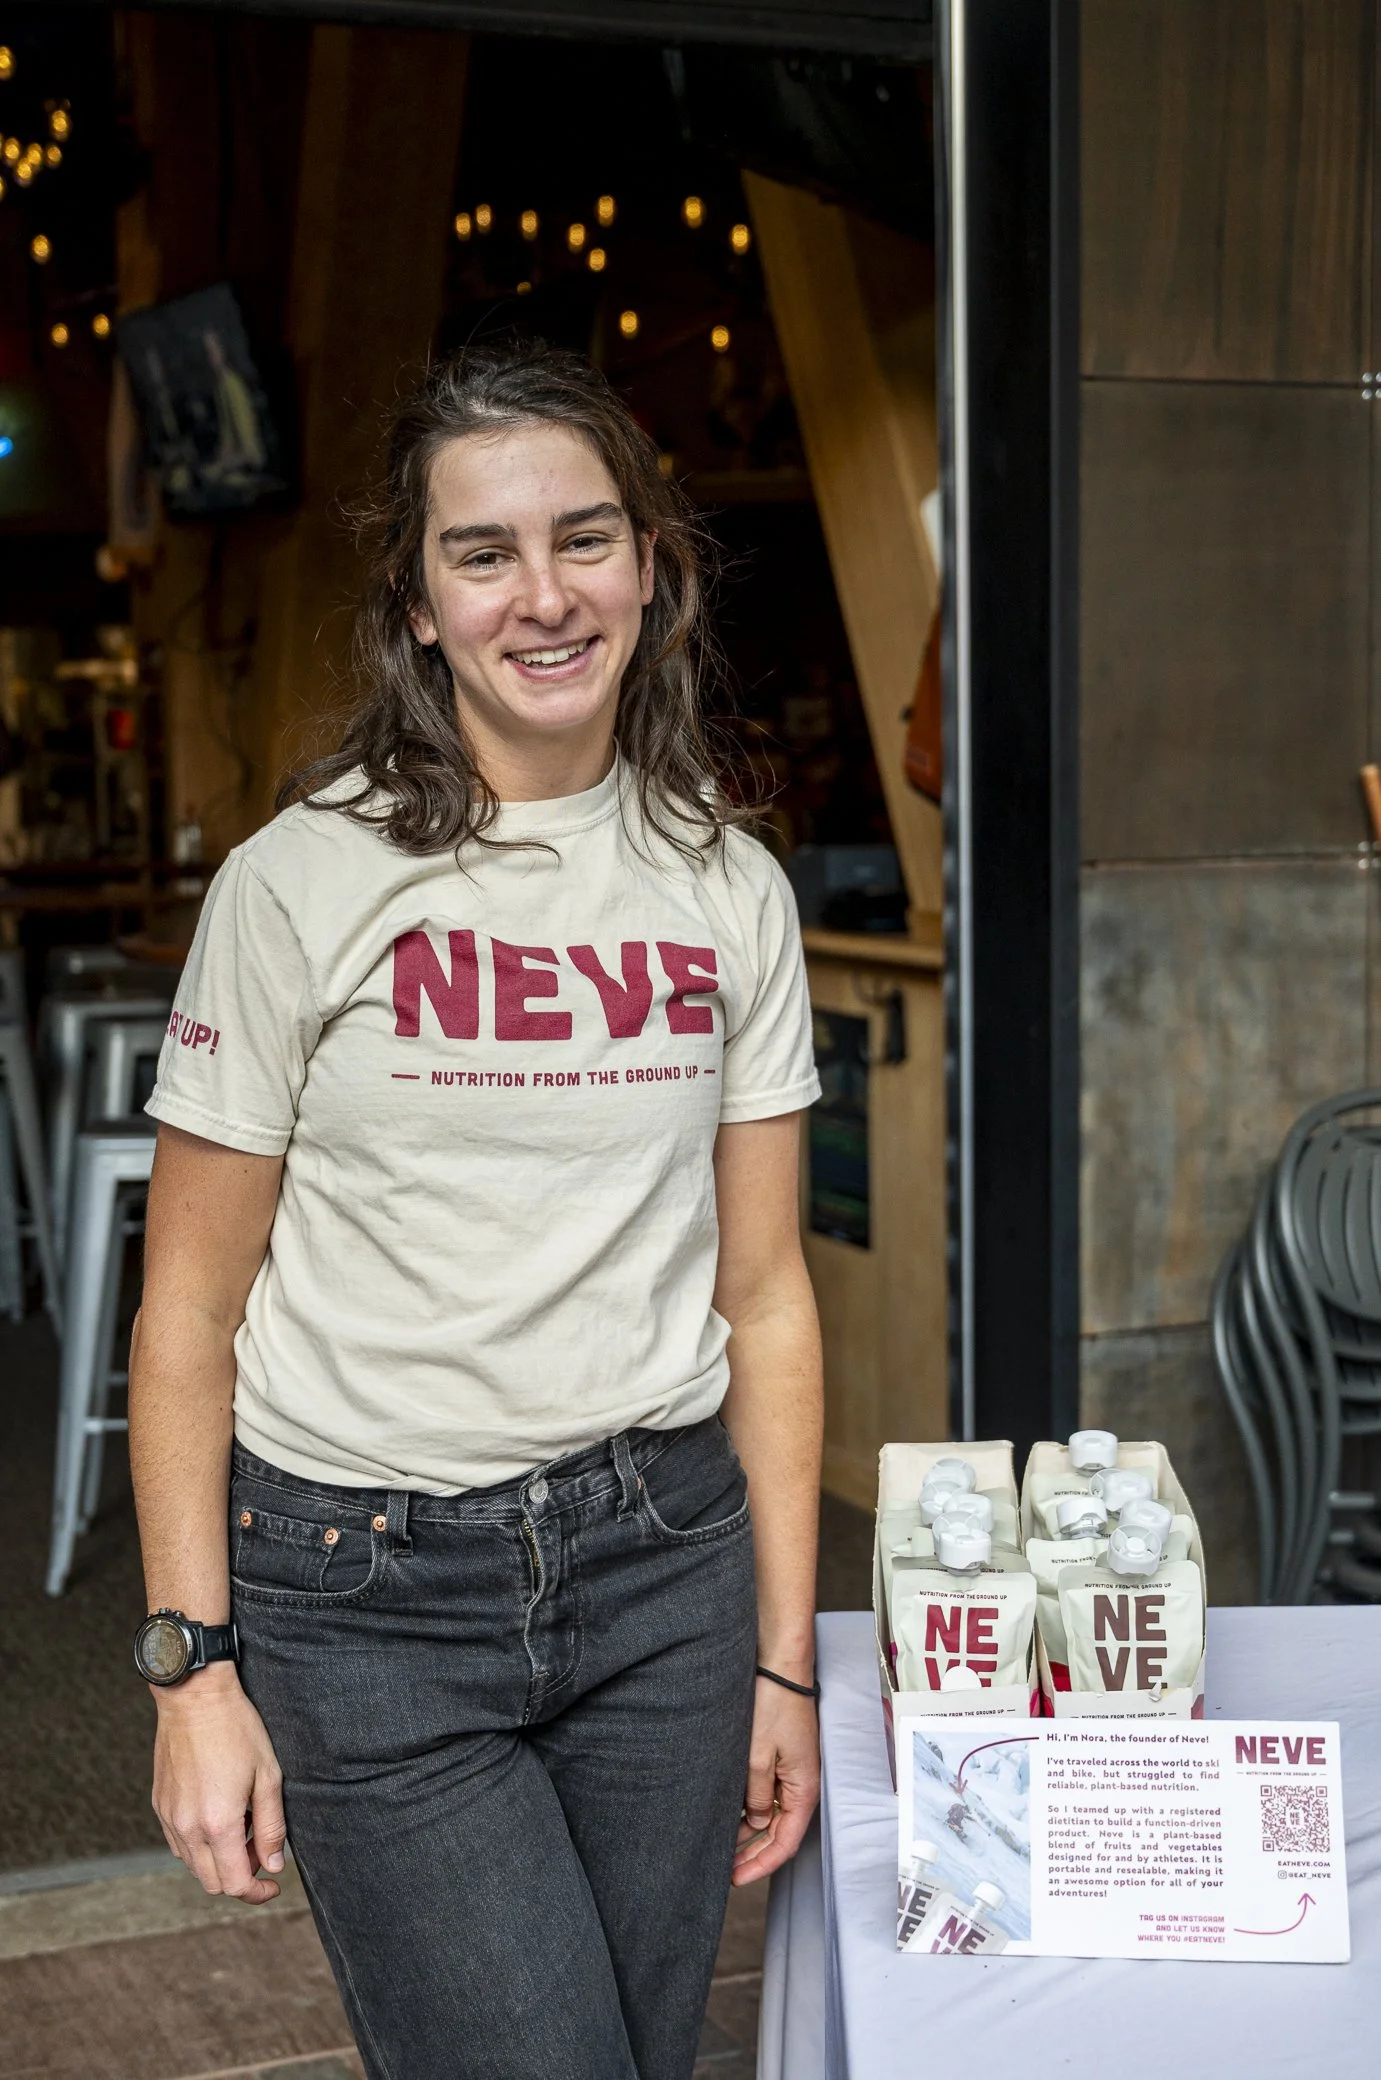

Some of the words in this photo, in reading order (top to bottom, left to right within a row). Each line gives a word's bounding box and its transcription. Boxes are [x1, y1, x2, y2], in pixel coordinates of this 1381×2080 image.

[392, 929, 718, 1041] NEVE
[181, 1018, 220, 1055] UP!
[431, 1071, 525, 1087] NUTRITION
[533, 1072, 580, 1086] FROM
[587, 1071, 618, 1085] THE
[626, 1067, 681, 1083] GROUND
[685, 1065, 698, 1079] UP
[1094, 1594, 1166, 1641] NE
[925, 1604, 998, 1654] NE
[1095, 1647, 1168, 1691] VE
[1047, 1734, 1060, 1742] Hi,
[1082, 1734, 1106, 1742] Nora,
[1110, 1734, 1126, 1742] the
[1129, 1734, 1166, 1743] founder
[1235, 1736, 1326, 1765] NEVE
[1067, 1758, 1106, 1766] traveled
[1143, 1759, 1158, 1767] the
[1162, 1759, 1189, 1767] world
[1072, 1770, 1095, 1778] bike,
[1104, 1770, 1120, 1778] but
[1128, 1771, 1174, 1780] struggled
[1047, 1782, 1087, 1790] reliable,
[1091, 1782, 1148, 1791] plant-based
[1151, 1783, 1199, 1791] nutrition.
[1048, 1805, 1059, 1813] So
[1073, 1806, 1108, 1814] teamed
[1114, 1807, 1126, 1815] up
[1132, 1806, 1153, 1815] with
[1170, 1807, 1221, 1817] registered
[1048, 1817, 1090, 1825] dietitian
[1094, 1818, 1104, 1826] to
[1108, 1818, 1132, 1826] build
[1145, 1819, 1221, 1827] function-driven
[1048, 1829, 1089, 1838] product.
[1133, 1830, 1140, 1838] is
[1164, 1831, 1221, 1840] plant-based
[1104, 1842, 1131, 1850] fruits
[1168, 1843, 1222, 1852] vegetables
[1048, 1853, 1092, 1862] designed
[1097, 1854, 1110, 1862] for
[1137, 1855, 1148, 1864] by
[1153, 1855, 1197, 1863] athletes.
[1202, 1855, 1210, 1863] It
[1215, 1855, 1222, 1863] is
[1049, 1865, 1090, 1874] portable
[1116, 1866, 1170, 1875] resealable,
[1175, 1867, 1210, 1877] making
[1215, 1867, 1223, 1875] it
[1114, 1878, 1146, 1887] option
[1151, 1878, 1164, 1886] for
[1170, 1879, 1182, 1887] all
[1186, 1879, 1196, 1887] of
[1201, 1880, 1223, 1888] your
[1049, 1889, 1107, 1898] adventures!
